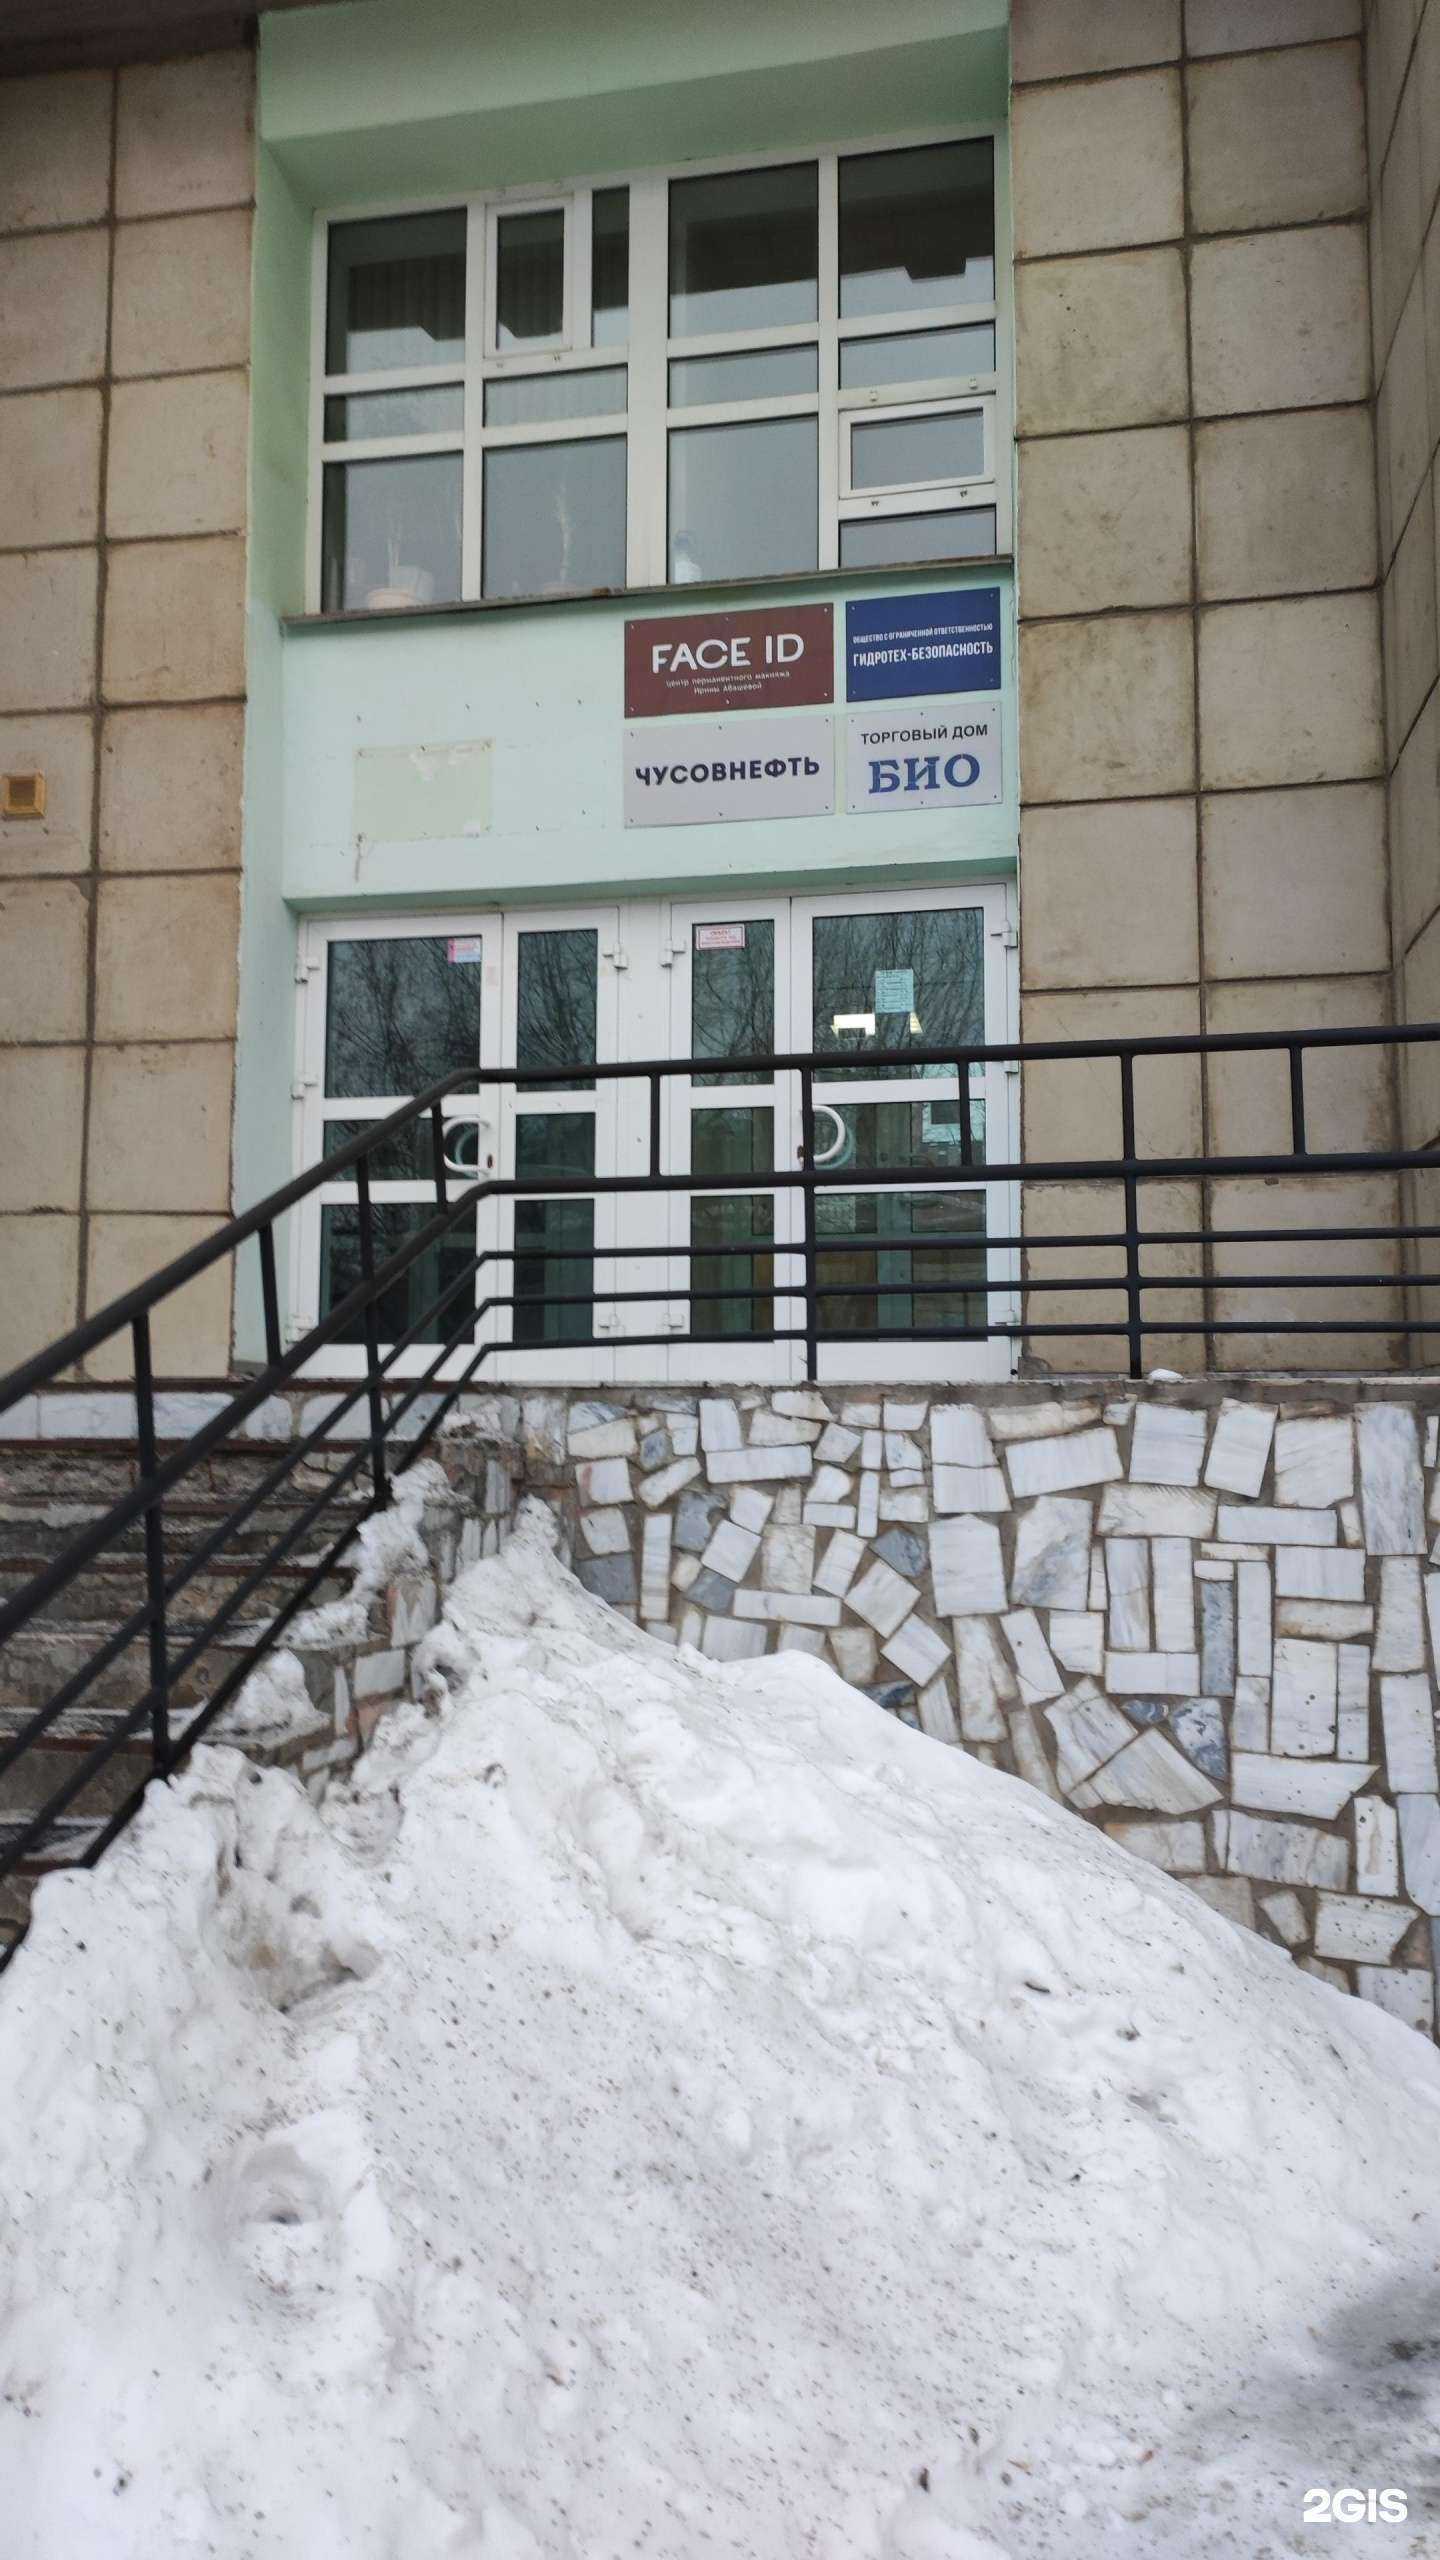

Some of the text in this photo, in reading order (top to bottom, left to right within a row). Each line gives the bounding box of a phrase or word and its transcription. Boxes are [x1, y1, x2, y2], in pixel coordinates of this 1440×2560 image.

[853, 634, 884, 644] ОБЩЕСТВО
[889, 627, 933, 640] ОГРАНИЧЕННОЙ
[934, 622, 993, 635] ОТВЕТСТВЕННОСТЬЮ
[652, 633, 805, 673] FACE ID
[853, 641, 993, 667] ГИДРОТЕХ-БЕЗОПАСНОСТЬ
[861, 724, 988, 745] ТОРГОВЫЙ ДОМ
[635, 757, 820, 786] ЧУСОВНЕФТЬ
[868, 753, 981, 794] БИО
